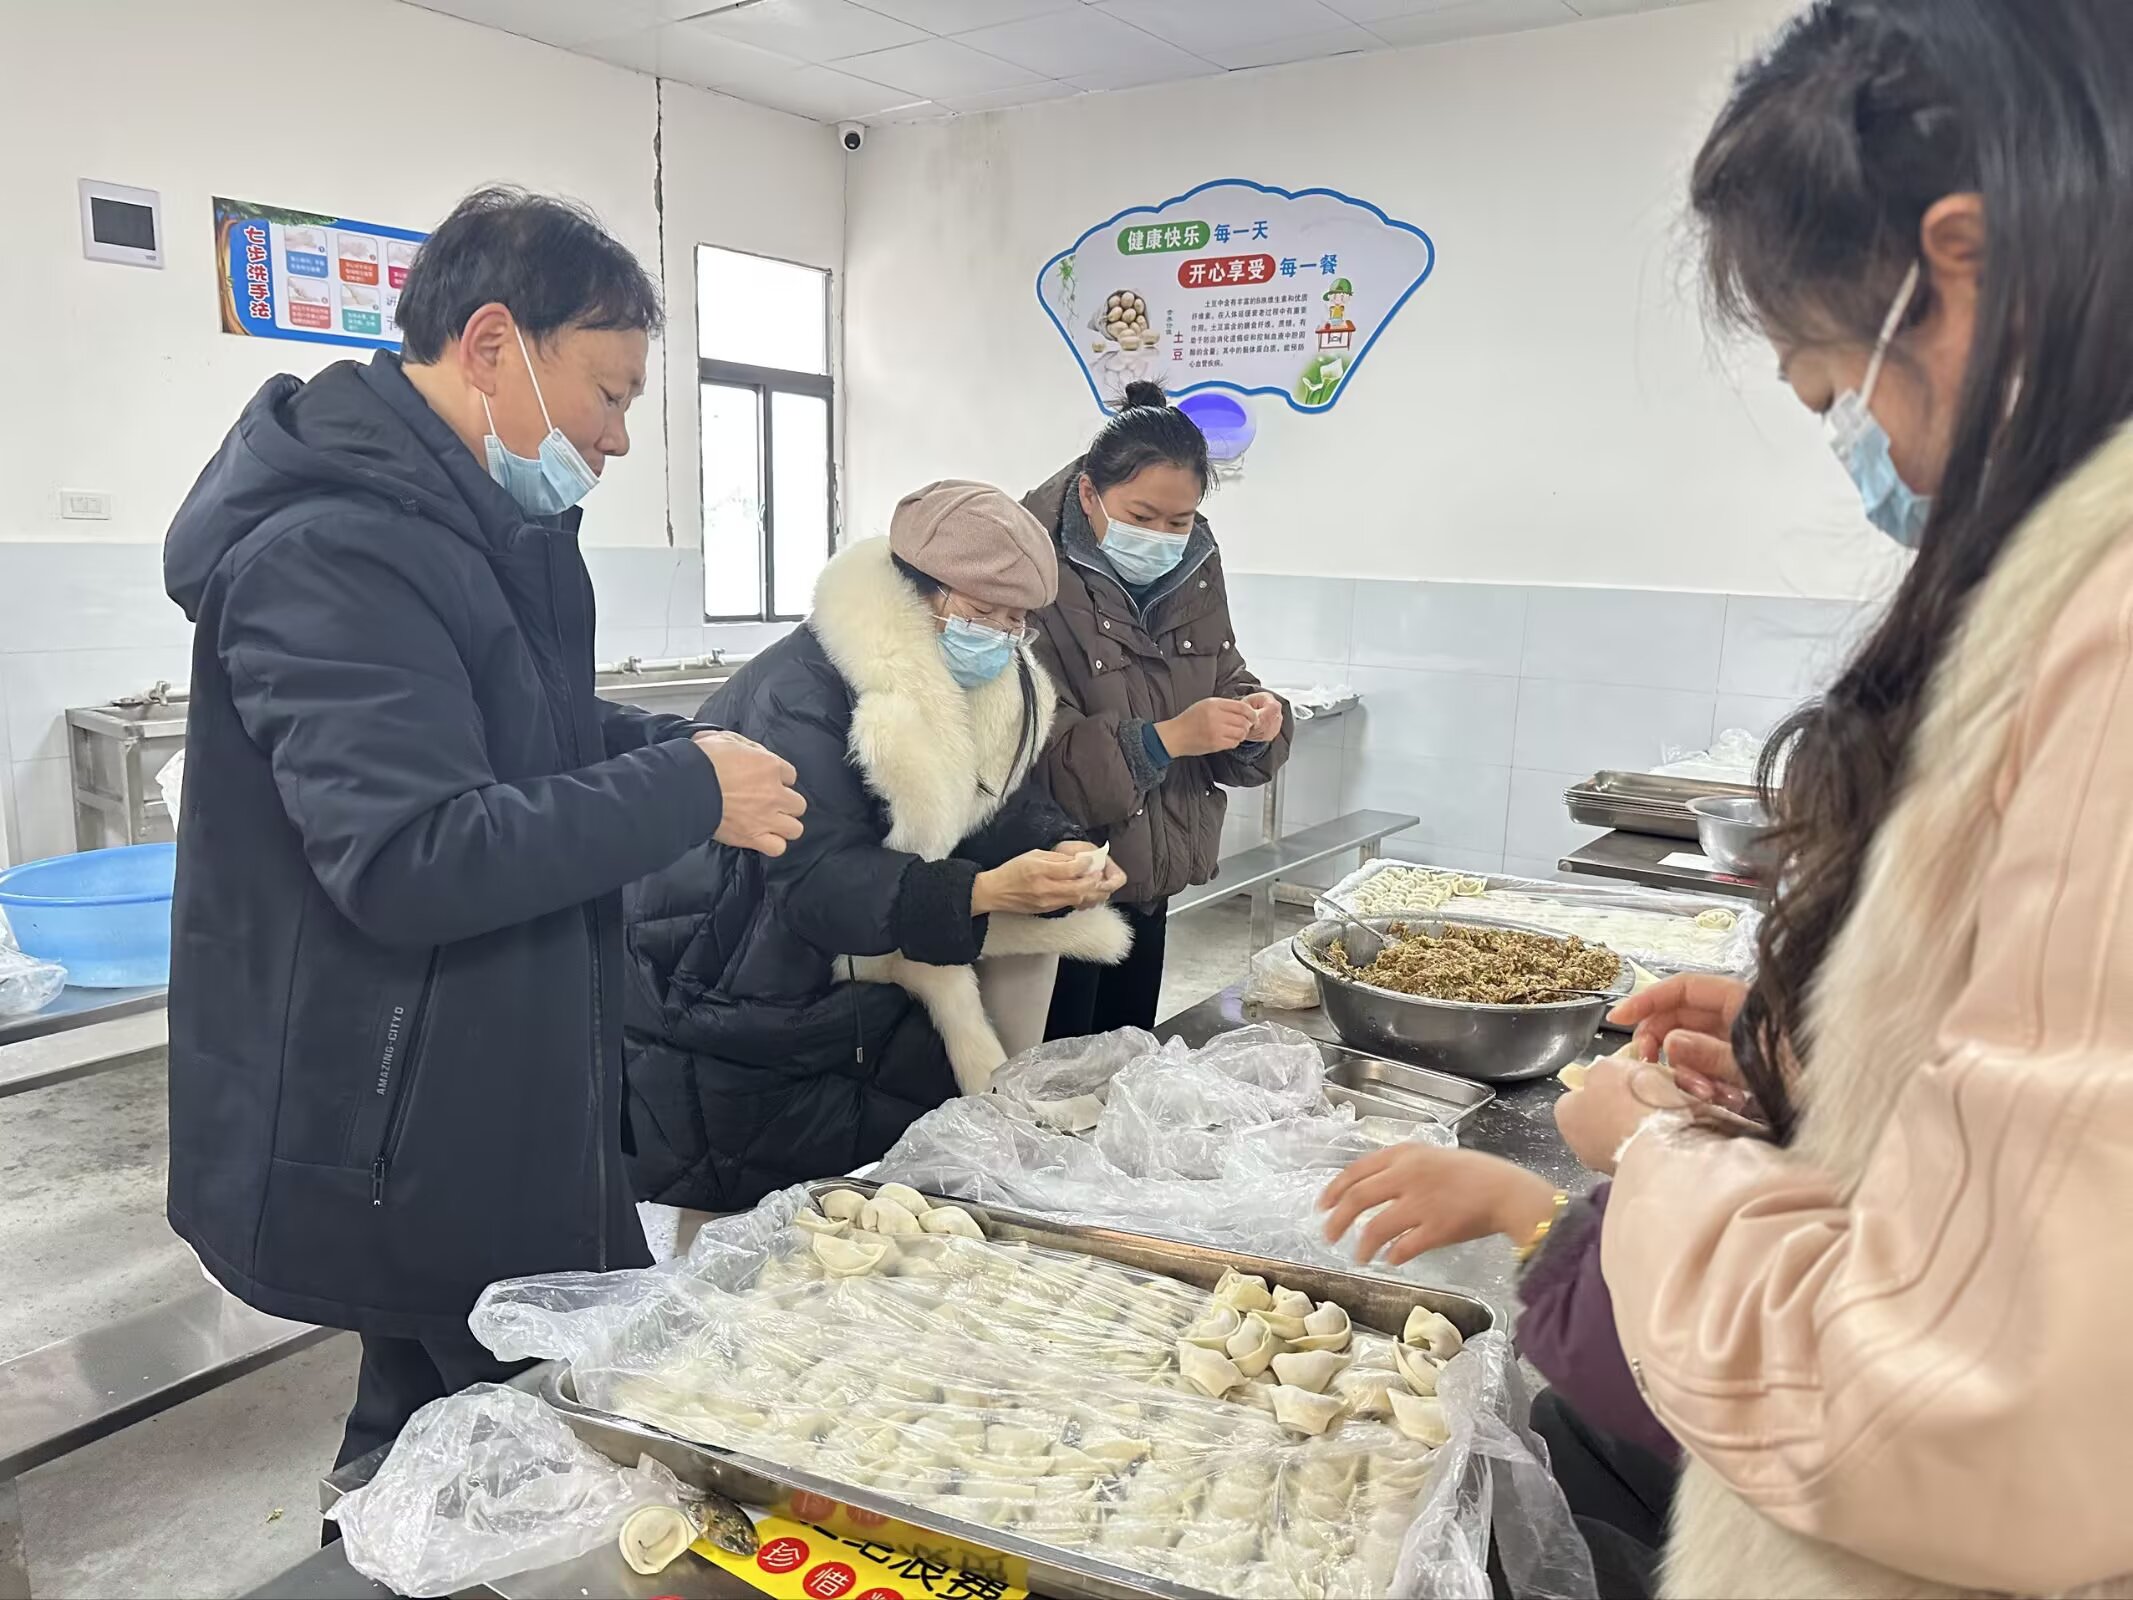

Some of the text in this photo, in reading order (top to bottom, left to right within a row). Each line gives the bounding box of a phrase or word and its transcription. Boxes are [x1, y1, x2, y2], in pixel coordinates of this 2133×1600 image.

[1127, 221, 1269, 251] 健康快乐 每一天
[245, 225, 272, 319] 七步洗手法
[1188, 254, 1338, 284] 开心享受 每一餐
[1172, 330, 1183, 360] 土豆
